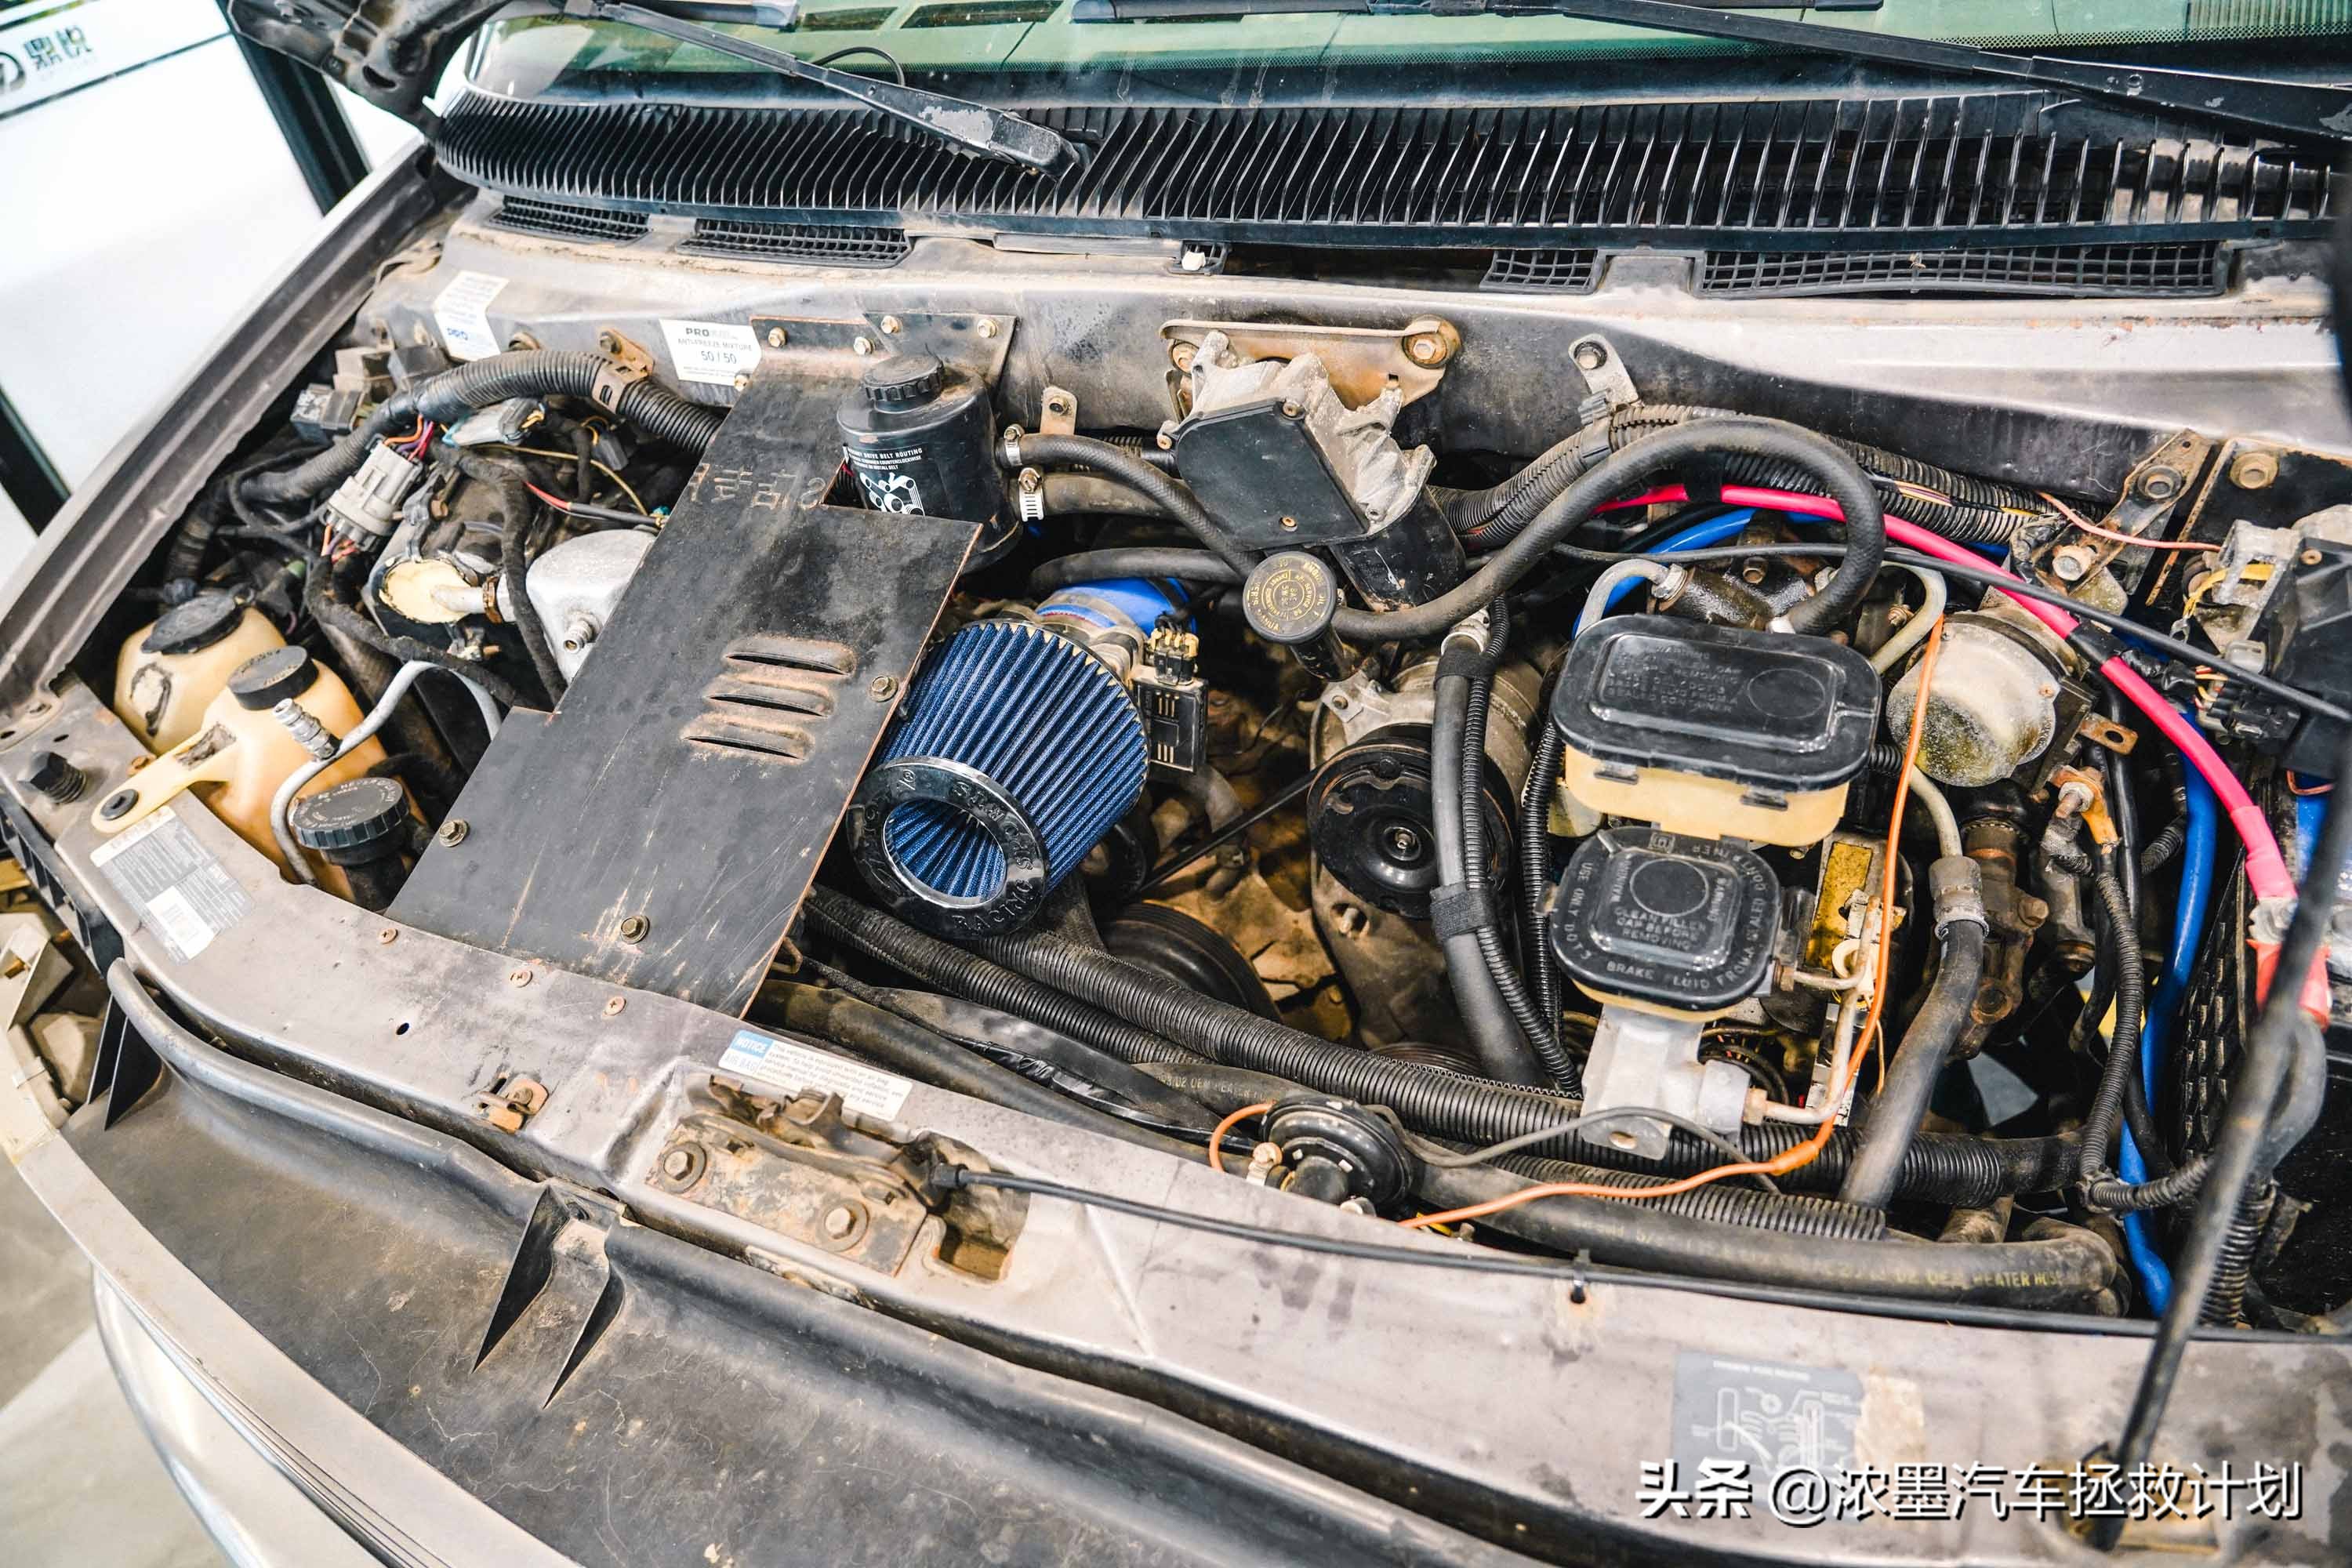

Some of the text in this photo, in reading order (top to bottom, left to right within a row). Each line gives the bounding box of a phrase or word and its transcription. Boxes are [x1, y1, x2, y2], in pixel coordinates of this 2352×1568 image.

[895, 448, 923, 458] ROUTING
[1303, 583, 1312, 608] SERVICE
[1577, 862, 1594, 884] USE
[1568, 887, 1585, 917] ONLY
[1614, 906, 1658, 924] CLEAN
[1622, 927, 1692, 951] REMOVING
[1646, 922, 1698, 942] BEFORE
[1606, 960, 1655, 980] BRAKE
[735, 1037, 767, 1054] NOTICE
[1973, 1271, 2029, 1287] HEATER
